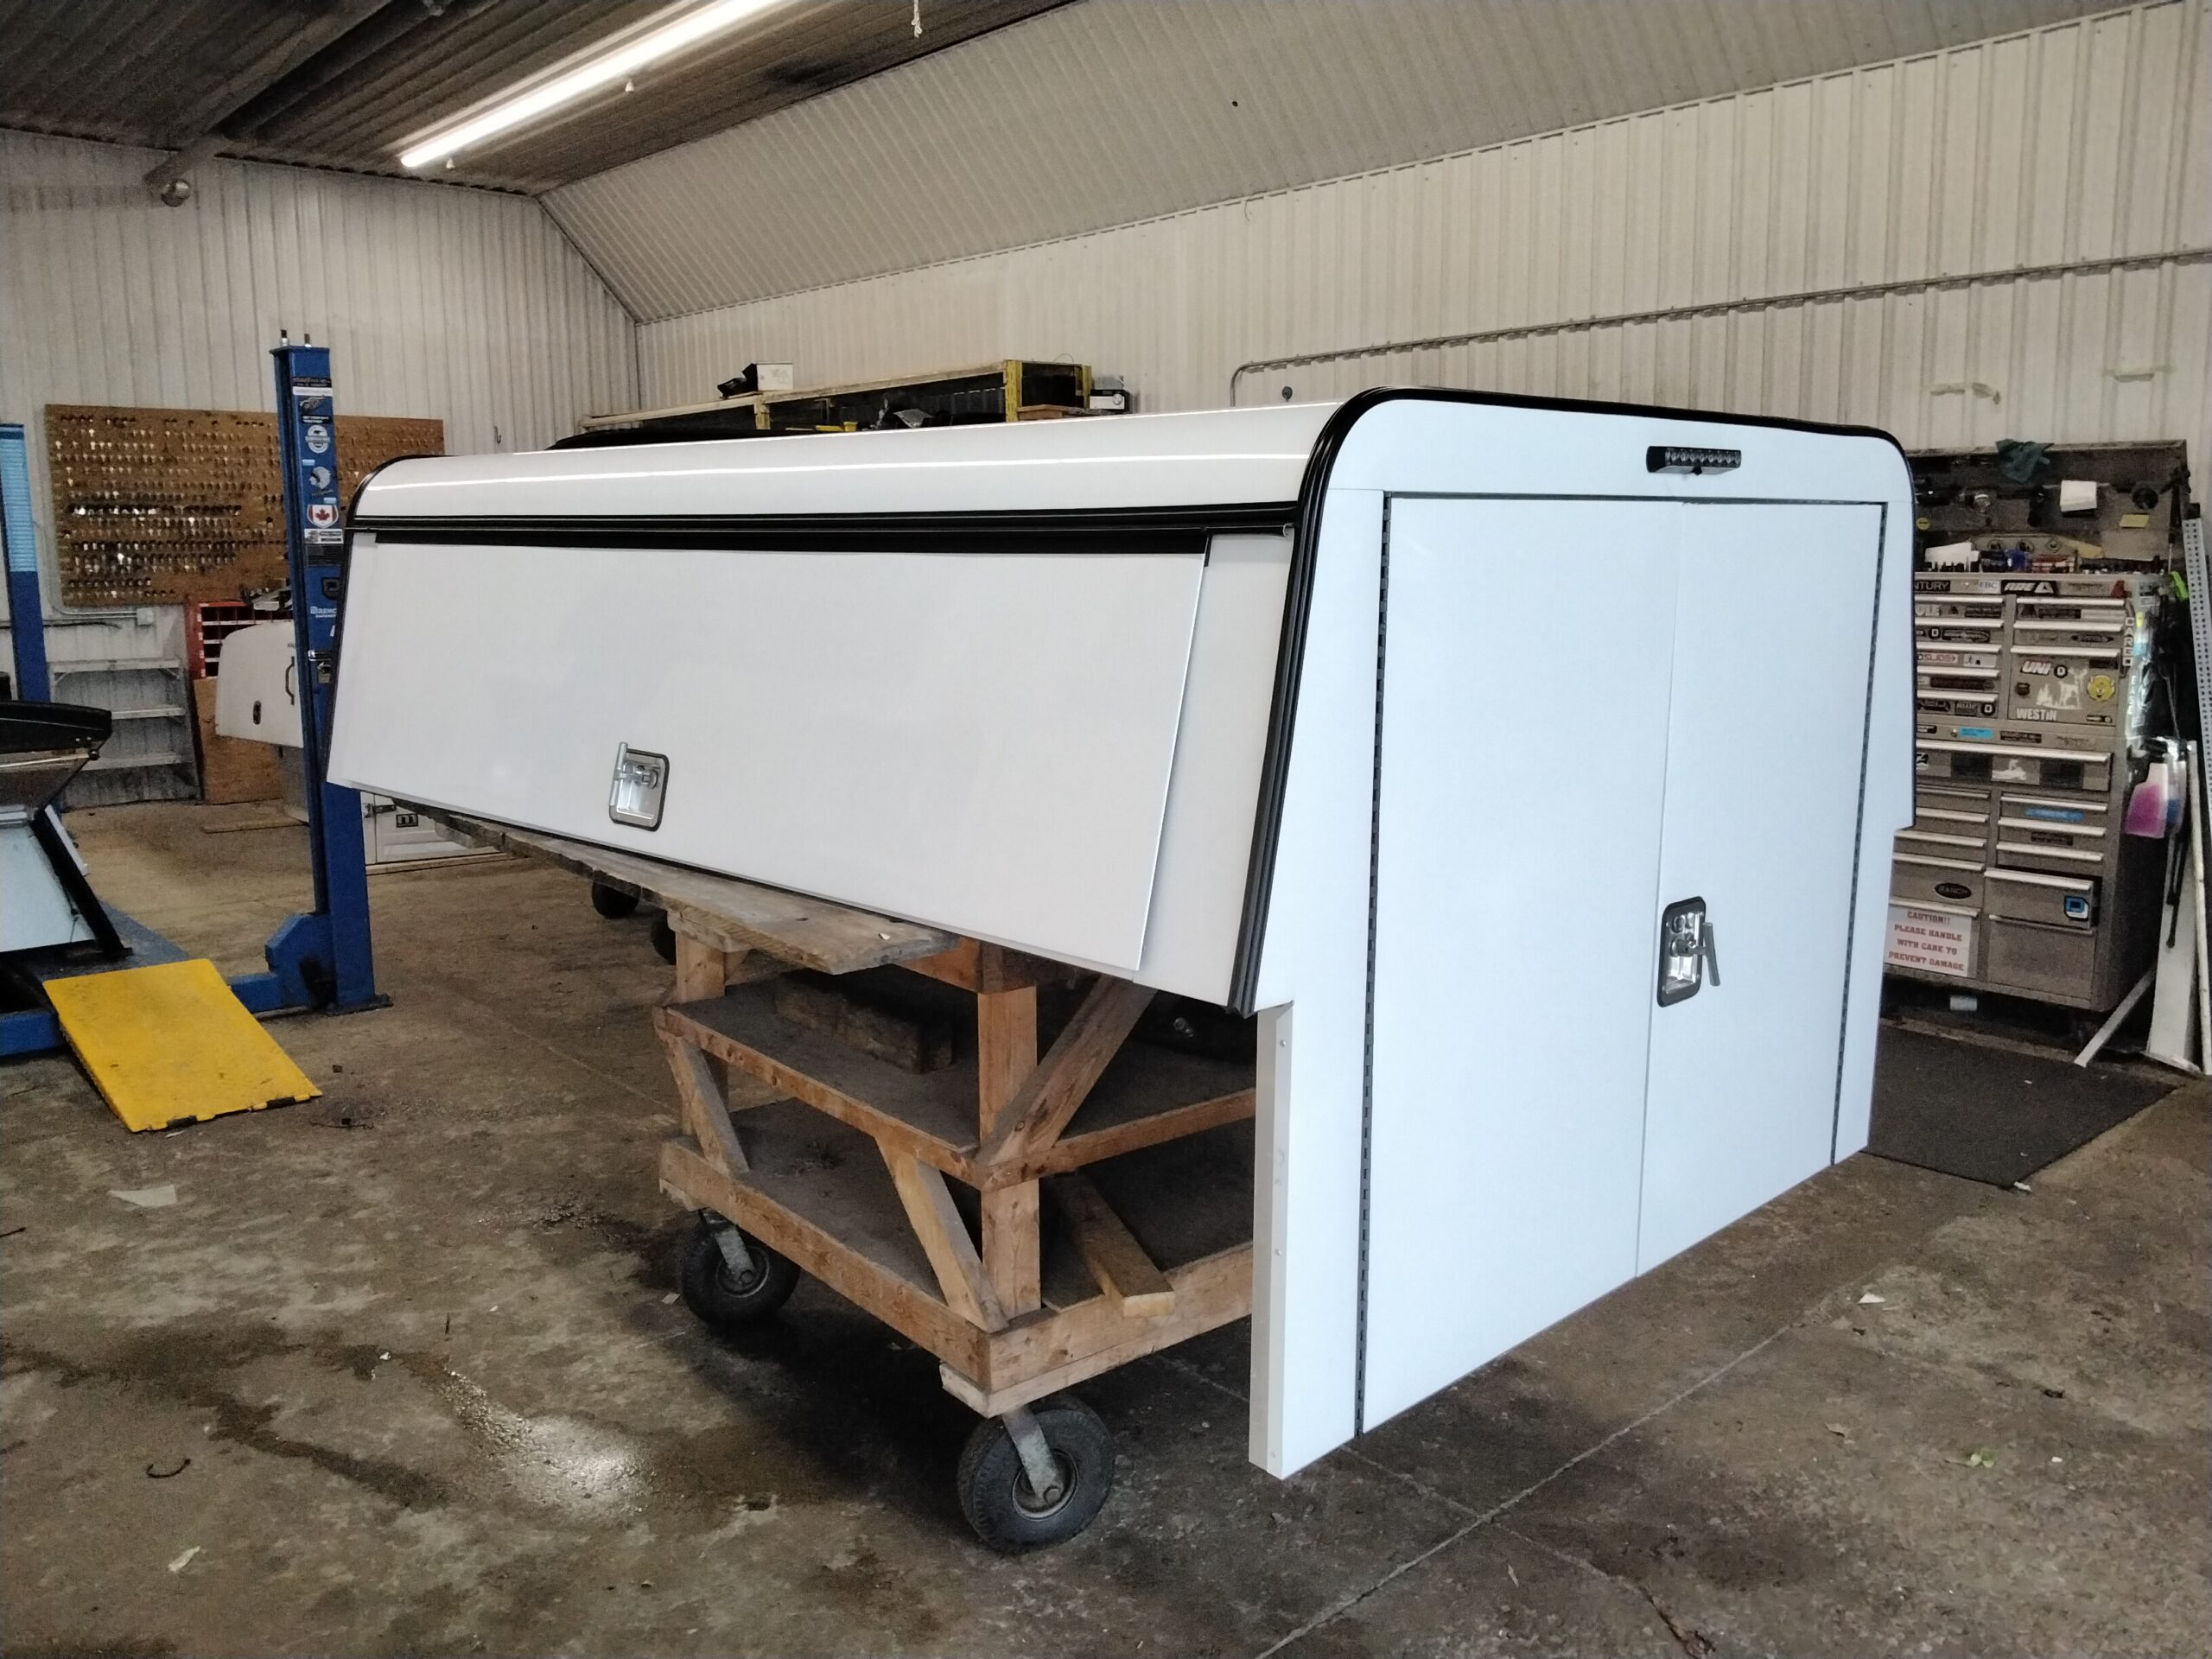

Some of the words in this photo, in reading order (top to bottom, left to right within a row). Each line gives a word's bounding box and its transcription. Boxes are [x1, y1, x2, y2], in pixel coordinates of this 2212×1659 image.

[2122, 617, 2135, 666] CARGO
[2022, 660, 2052, 675] UNI
[1907, 911, 1950, 925] CAUTION!!
[1893, 924, 1926, 936] PLEASE
[1929, 930, 1963, 942] HANDLE
[1897, 938, 1919, 949] WITH
[1921, 942, 1943, 953] CARE
[1945, 946, 1958, 956] TO
[1888, 950, 1927, 964] PREVENT
[1929, 958, 1964, 971] DAMAGE
